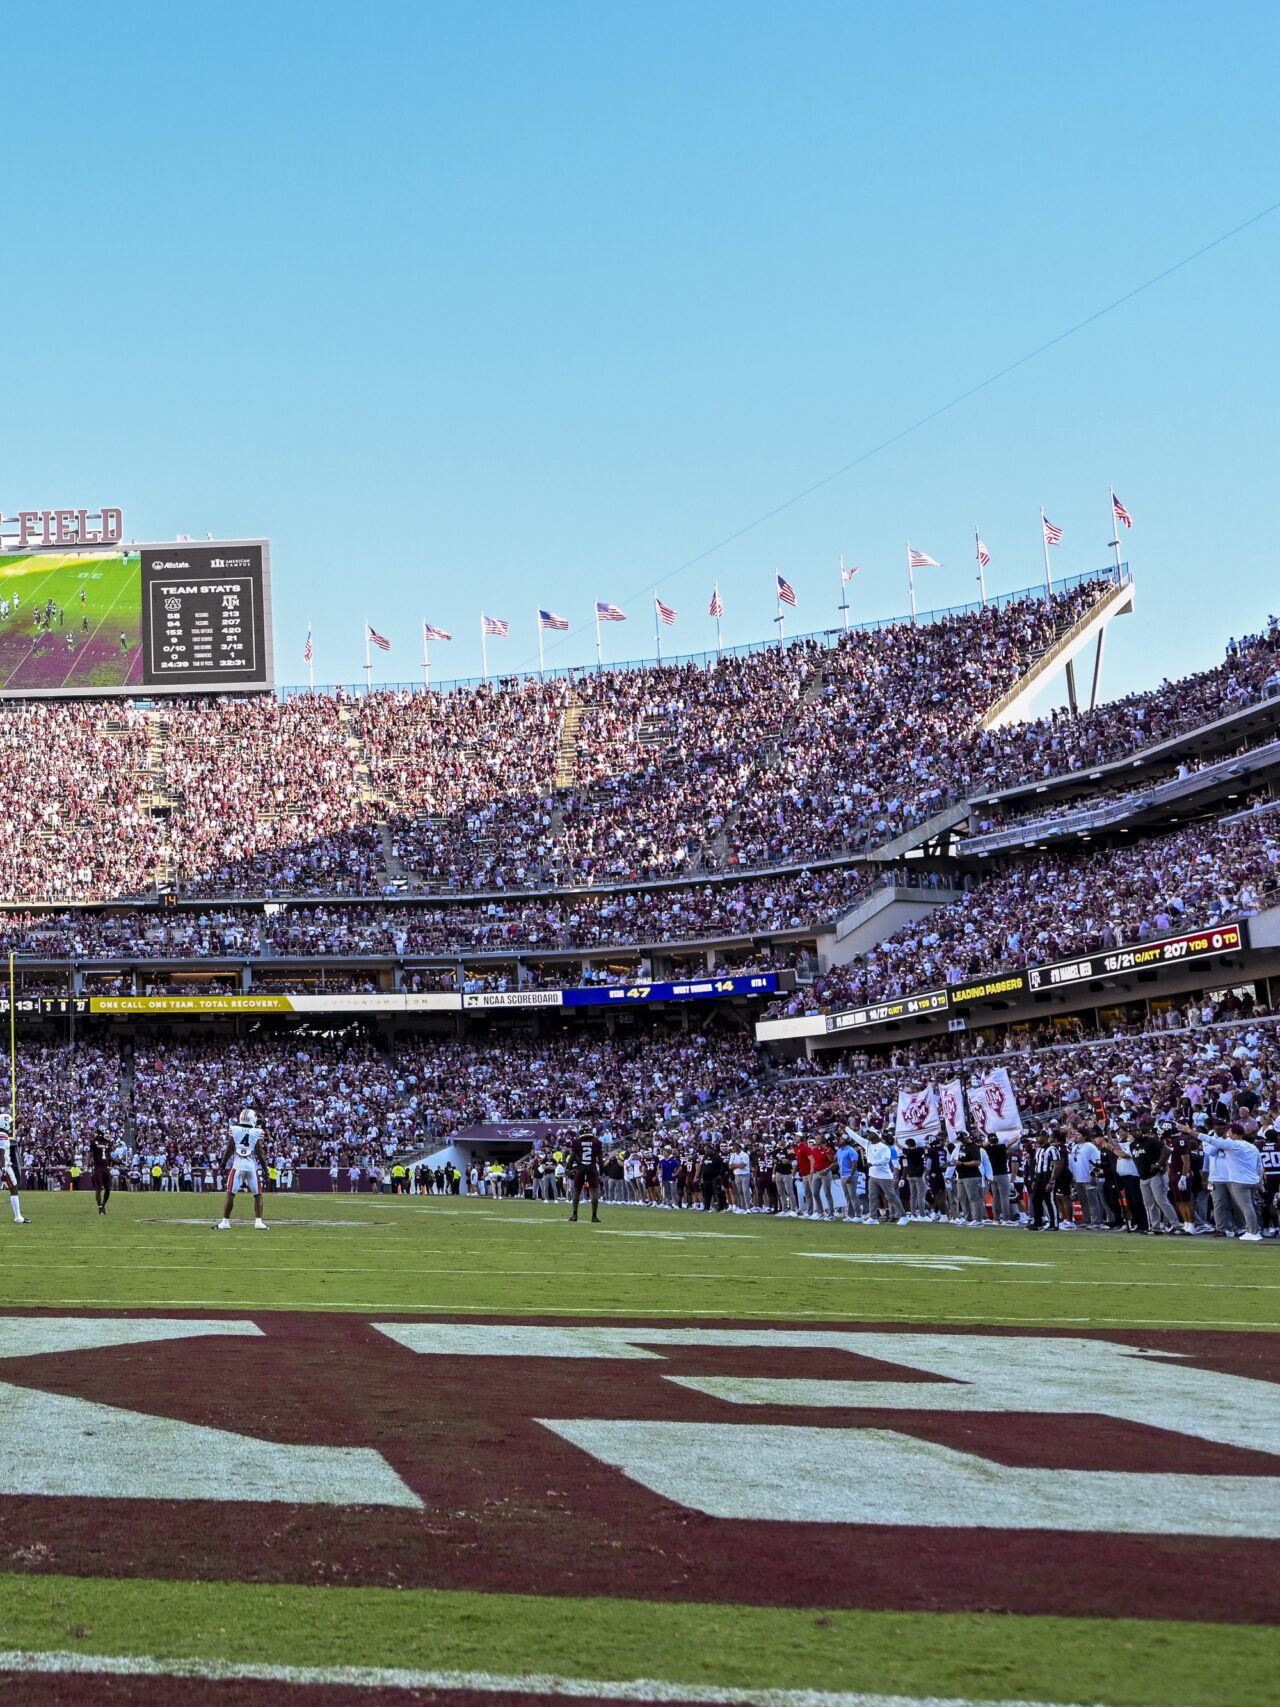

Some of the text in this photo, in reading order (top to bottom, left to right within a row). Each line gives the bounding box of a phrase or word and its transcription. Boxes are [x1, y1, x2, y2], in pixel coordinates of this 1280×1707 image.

[18, 508, 123, 546] FIELD
[160, 585, 241, 594] TEAM STATS
[1104, 953, 1135, 970] 15/21
[1135, 949, 1160, 963] C/ATT
[1164, 941, 1188, 958] 207
[1189, 939, 1208, 951] YDS
[1212, 934, 1223, 948] 0
[1223, 933, 1237, 944] TD
[715, 981, 734, 991] 14
[952, 978, 1023, 1002] LEADING PASSERS
[626, 987, 651, 998] 47
[483, 993, 558, 1005] NCAA SCOREBOARD
[931, 997, 938, 1007] 0
[938, 996, 946, 1004] TD
[15, 1001, 33, 1011] 13
[239, 1133, 250, 1147] 4
[102, 1148, 106, 1159] 1
[581, 1147, 592, 1161] 2
[1261, 1151, 1280, 1168] 20
